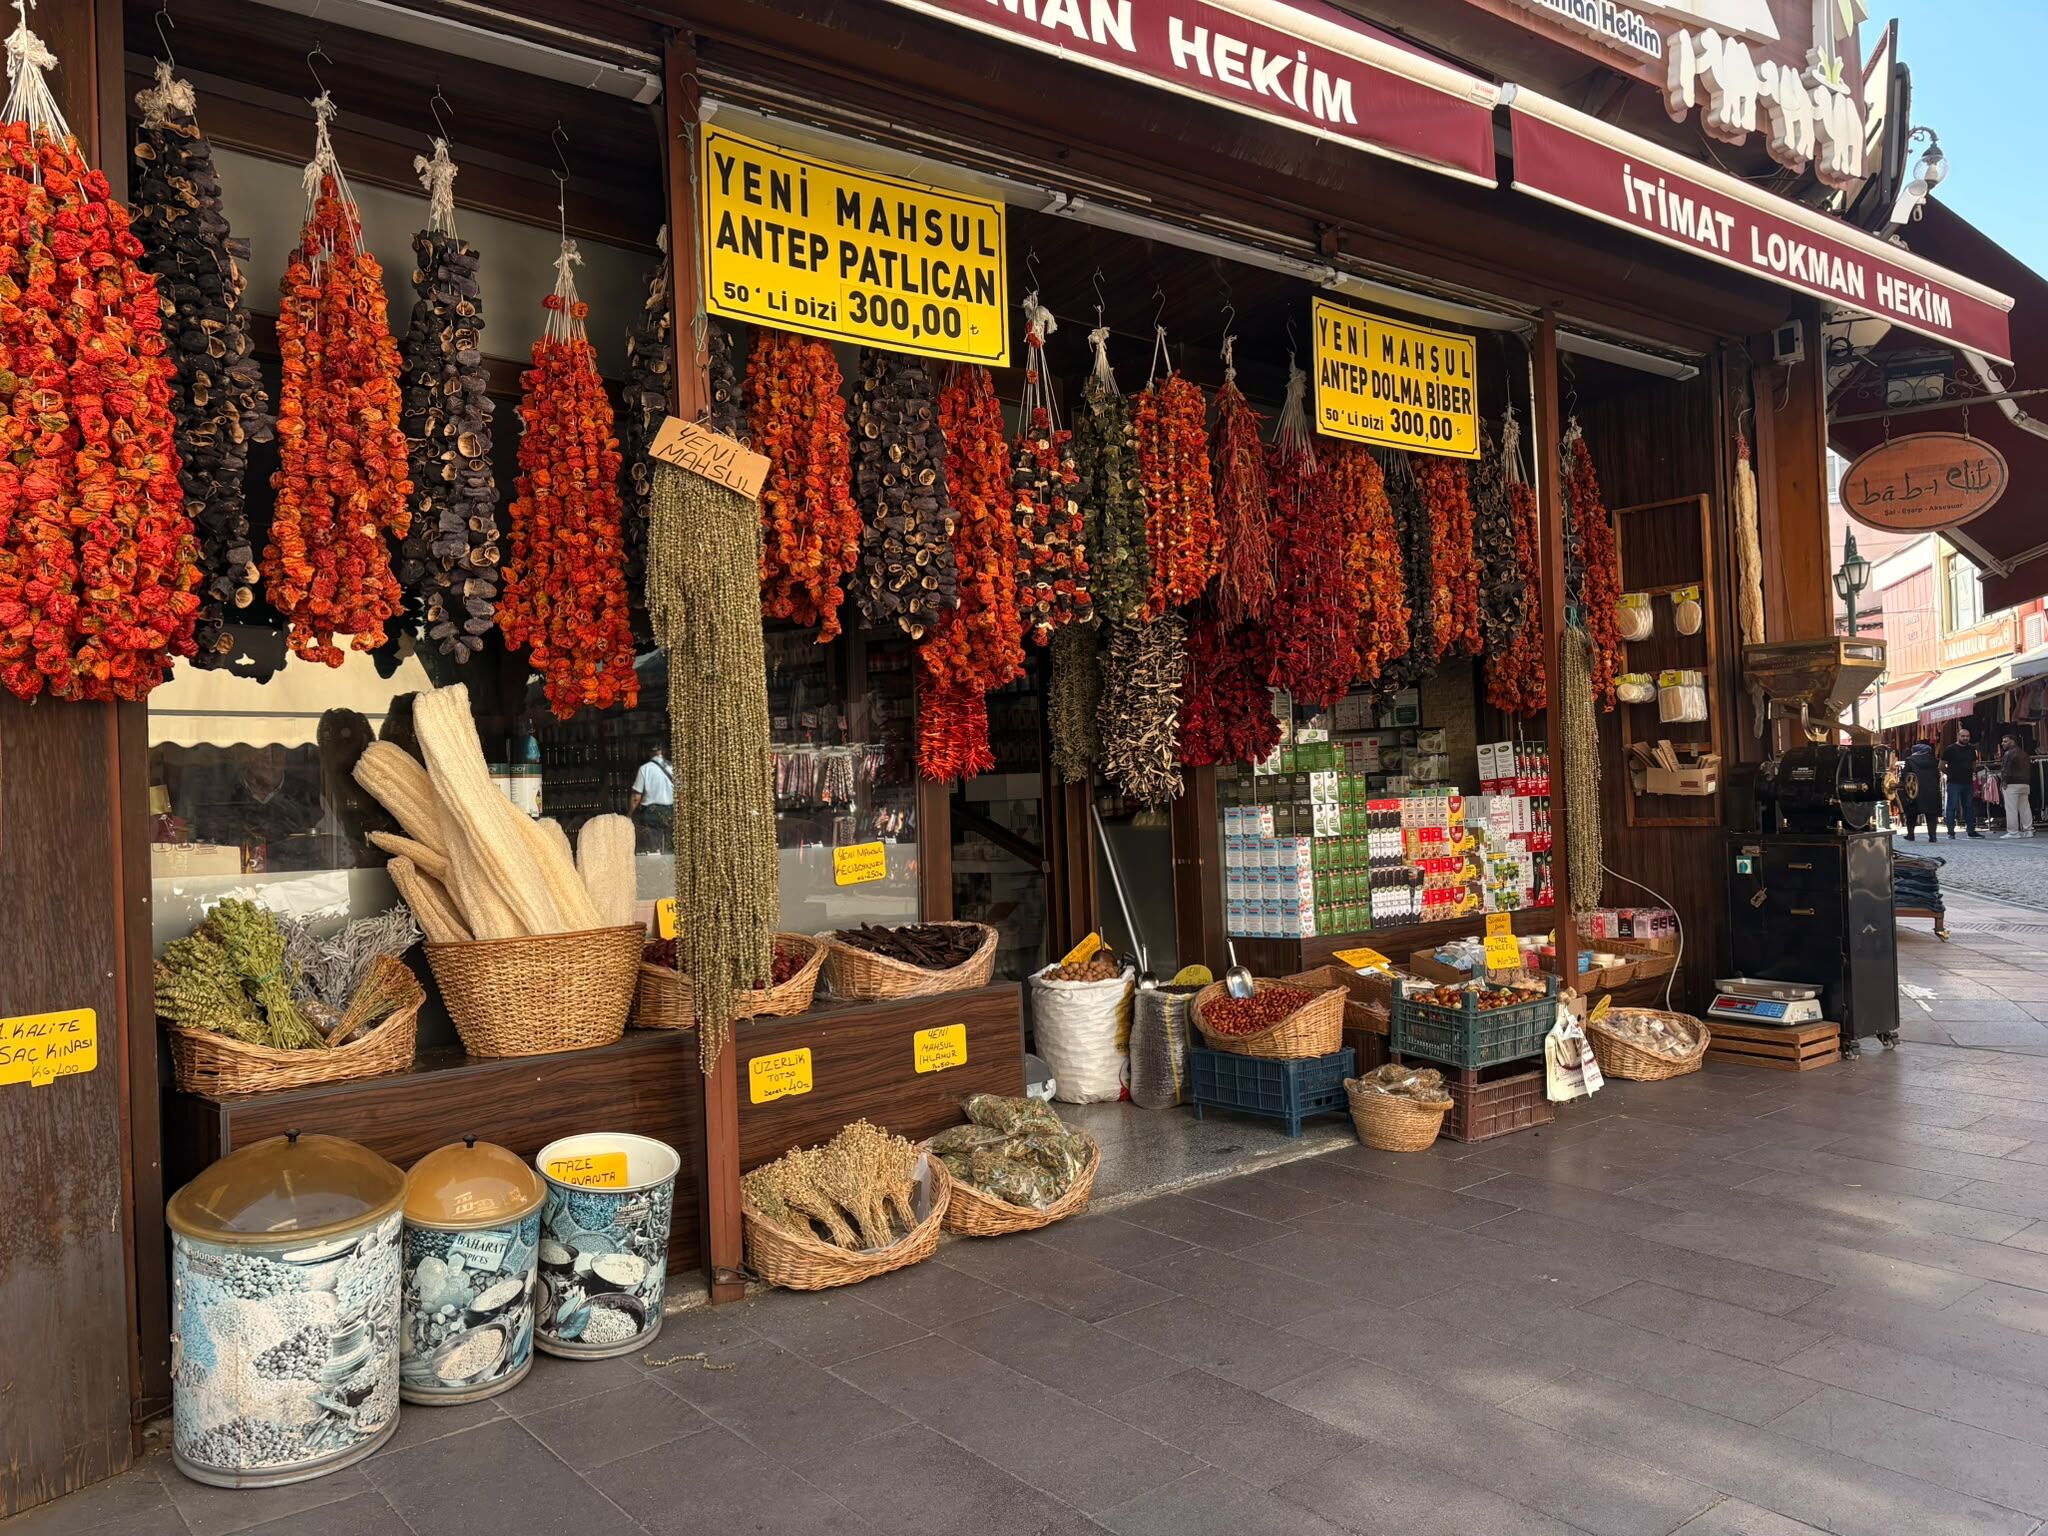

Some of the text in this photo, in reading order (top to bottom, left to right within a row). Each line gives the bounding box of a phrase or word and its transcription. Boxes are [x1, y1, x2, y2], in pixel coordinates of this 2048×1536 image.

[1601, 0, 1660, 55] Hekim
[1168, 16, 1358, 125] HEKİM
[714, 149, 996, 258] YENİ MAHSUL
[715, 210, 996, 307] ANTEP PATLICAN
[1622, 162, 1953, 330] İTİMAT LOKMAN HEKİM
[794, 296, 838, 323] DİZİ
[848, 290, 962, 340] 300,00
[1319, 316, 1471, 379] YENİ MAHSUL
[1321, 357, 1472, 416] ANTEP DOLMA BİBER
[677, 426, 739, 468] YENİ
[1361, 414, 1384, 432] DİZİ
[1390, 408, 1453, 443] 300,00
[656, 443, 756, 498] MAHSUL
[921, 1041, 955, 1052] MAHSUL
[550, 1158, 593, 1174] TAZE
[456, 1234, 506, 1254] BAHARAT
